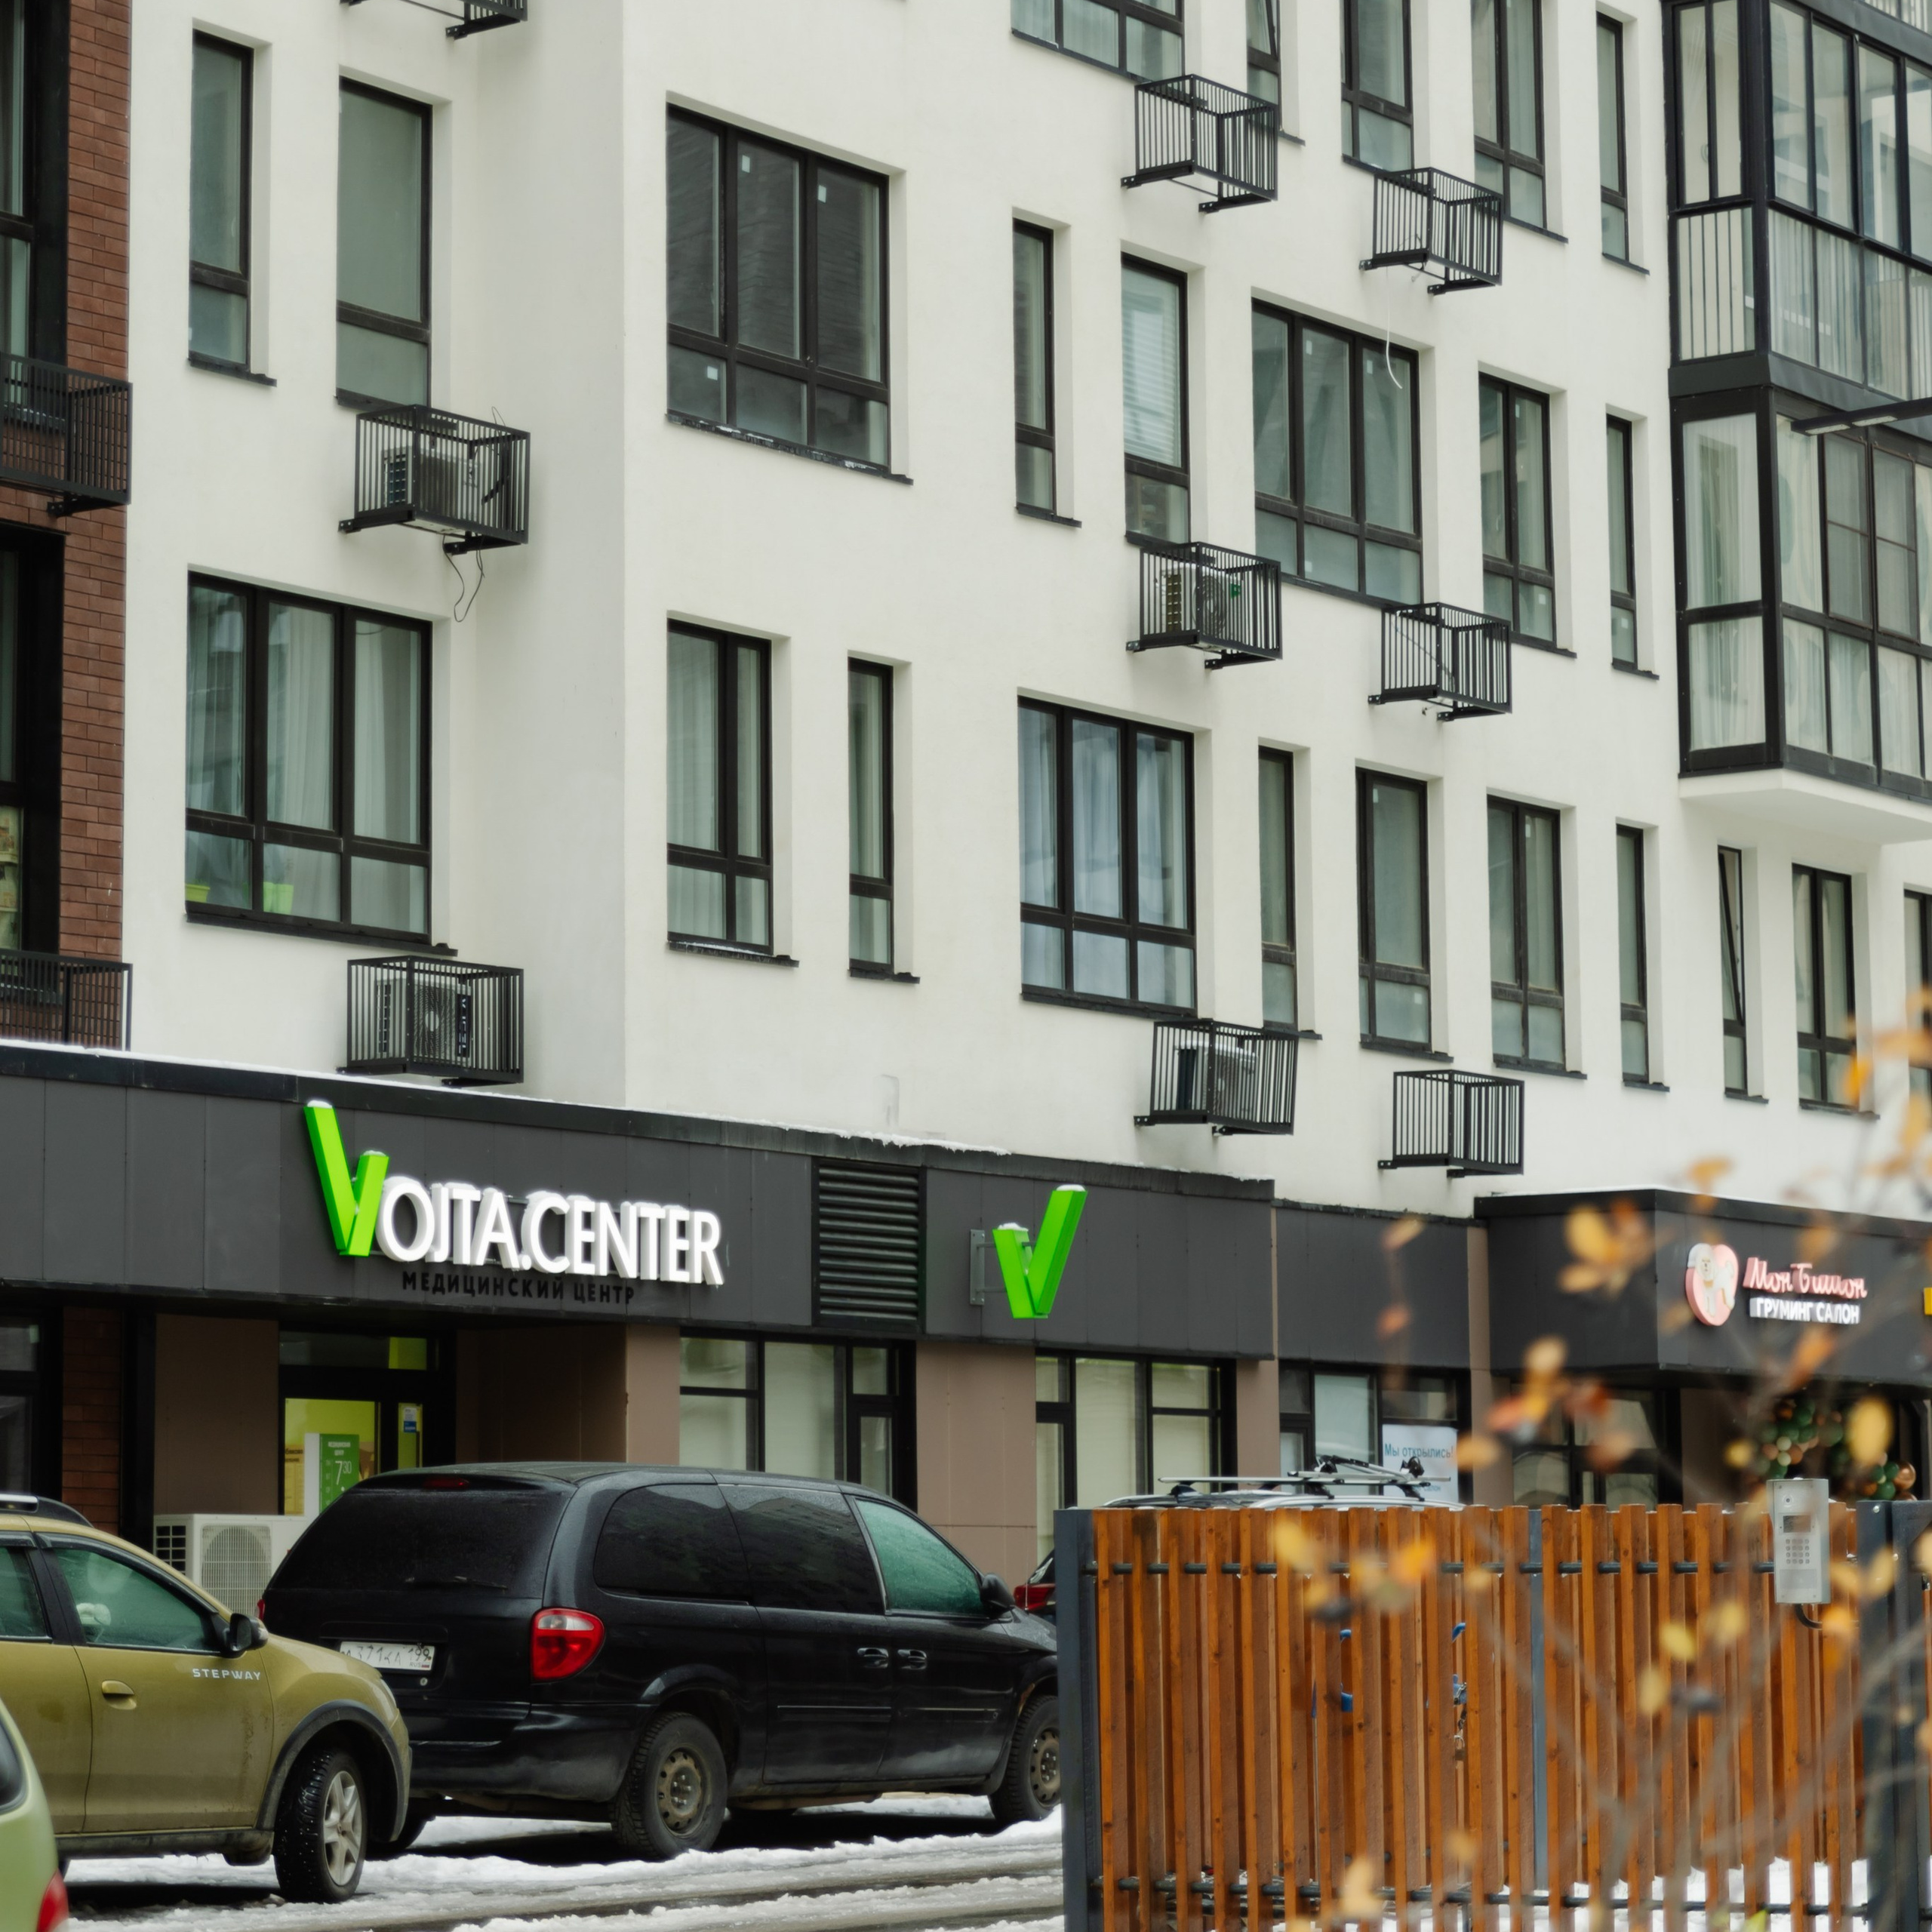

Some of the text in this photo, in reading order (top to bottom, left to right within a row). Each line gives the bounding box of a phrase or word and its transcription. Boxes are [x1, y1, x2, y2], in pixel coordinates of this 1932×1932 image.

[303, 1106, 724, 1285] VOJTA.CENTER
[402, 1271, 635, 1305] МЕДИЦИНСКИЙ ЦЕНТР
[1744, 1257, 1867, 1299] Мон Бишон
[1752, 1297, 1861, 1324] ГРУМИНГ САЛОН
[1384, 1443, 1400, 1457] Мы
[192, 1668, 261, 1681] STEPWAY
